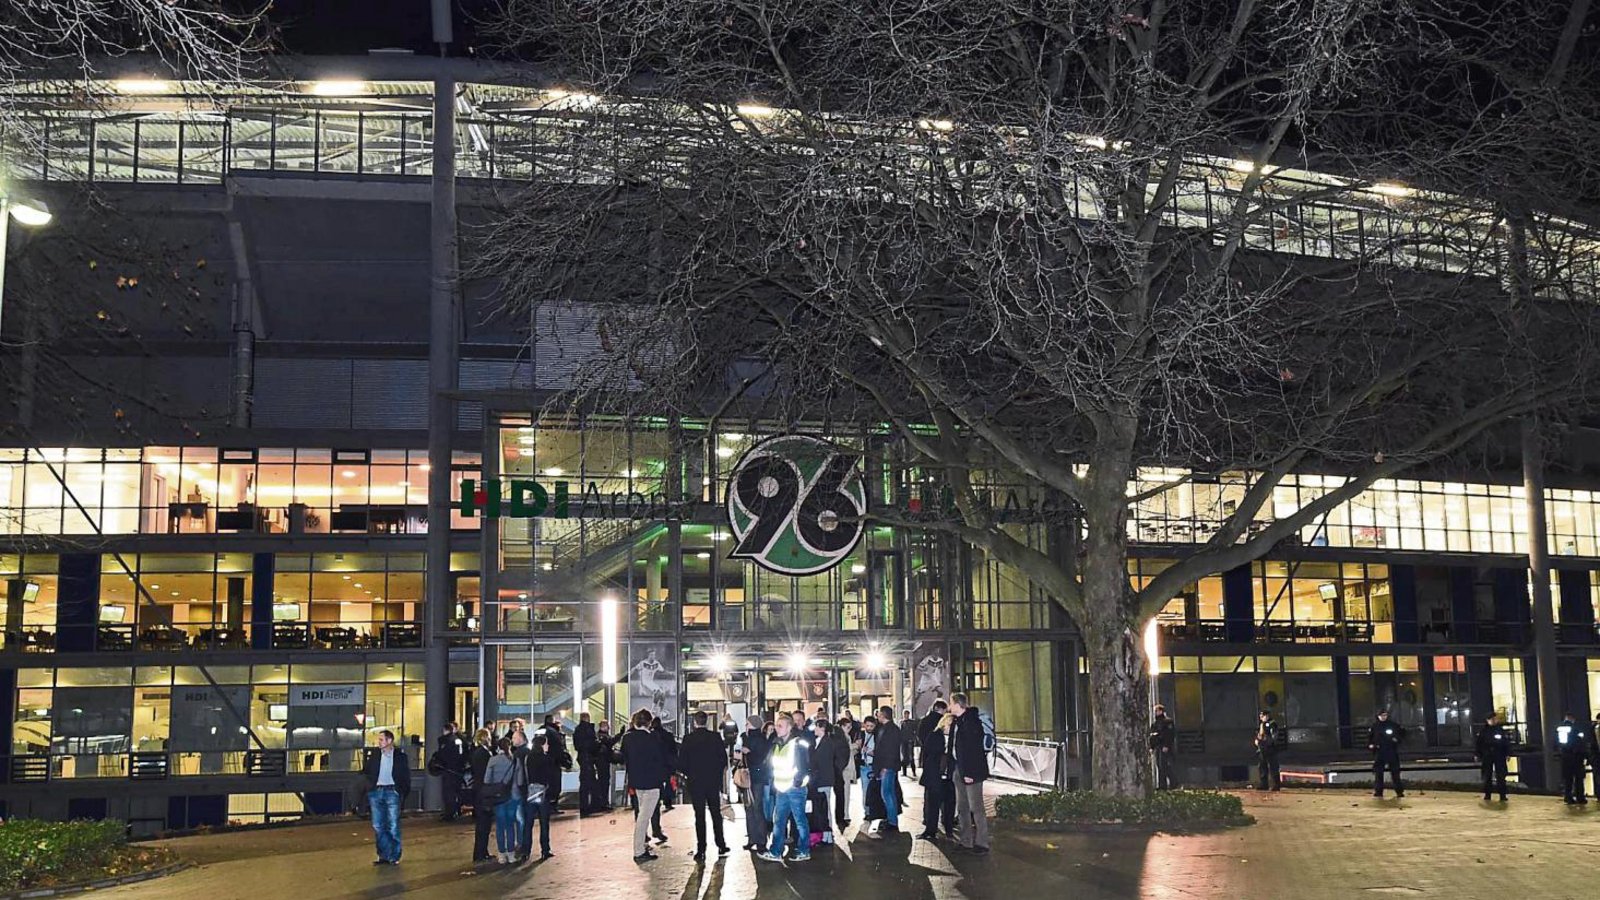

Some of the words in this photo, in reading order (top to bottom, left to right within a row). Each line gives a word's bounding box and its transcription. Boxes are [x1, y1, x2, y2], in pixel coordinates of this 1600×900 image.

[461, 479, 568, 518] HDI
[728, 448, 863, 562] 96
[185, 693, 207, 701] HDI
[302, 690, 323, 700] HDI
[325, 690, 348, 700] Arena
